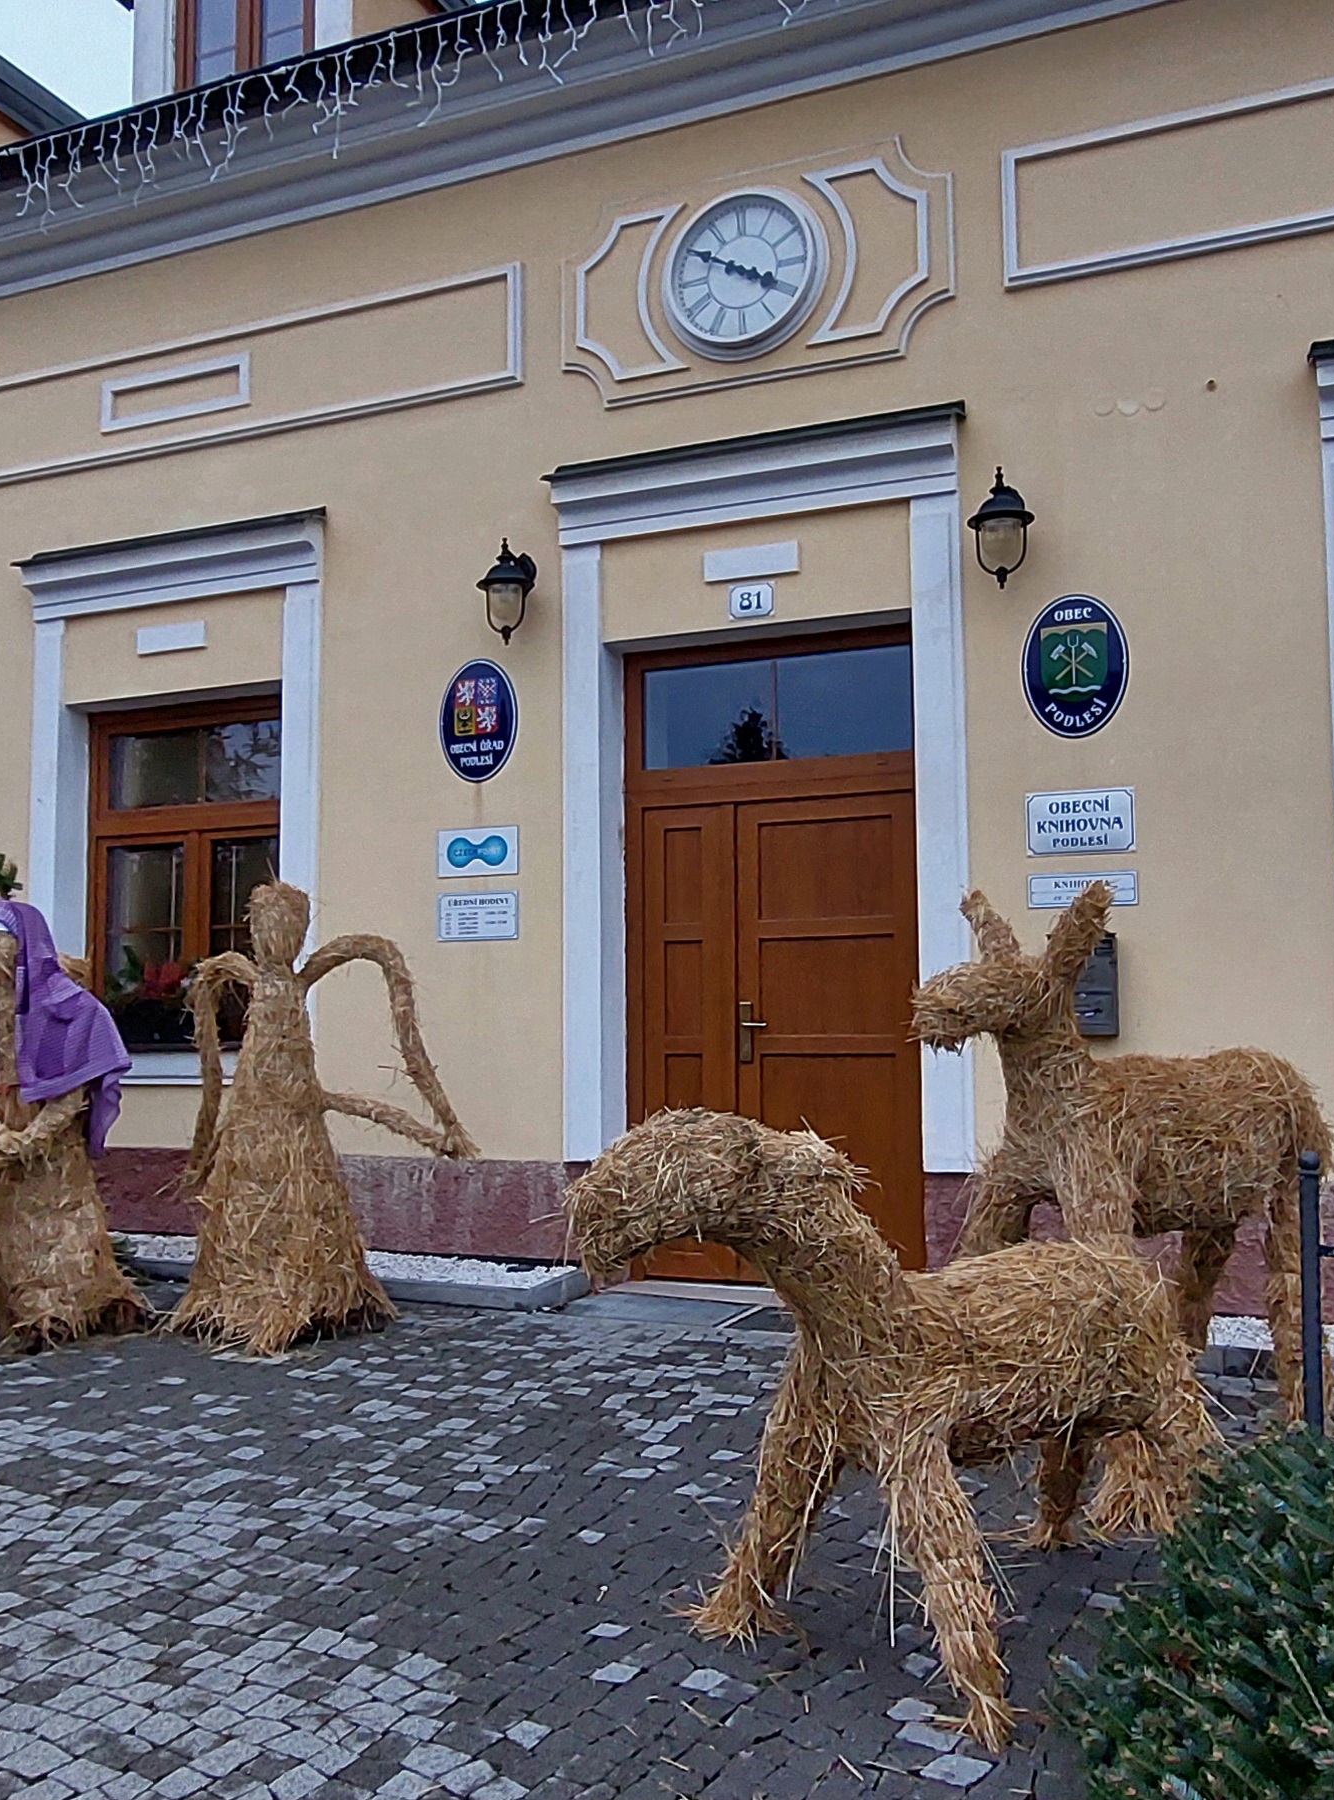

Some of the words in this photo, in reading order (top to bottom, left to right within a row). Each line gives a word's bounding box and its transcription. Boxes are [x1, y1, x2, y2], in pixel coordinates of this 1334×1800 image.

[739, 590, 763, 611] 81
[1054, 607, 1093, 621] OBEC
[1048, 795, 1110, 815] OBECNÍ
[1036, 816, 1124, 834] KNIHOVNA
[1052, 833, 1109, 848] PODLESÍ
